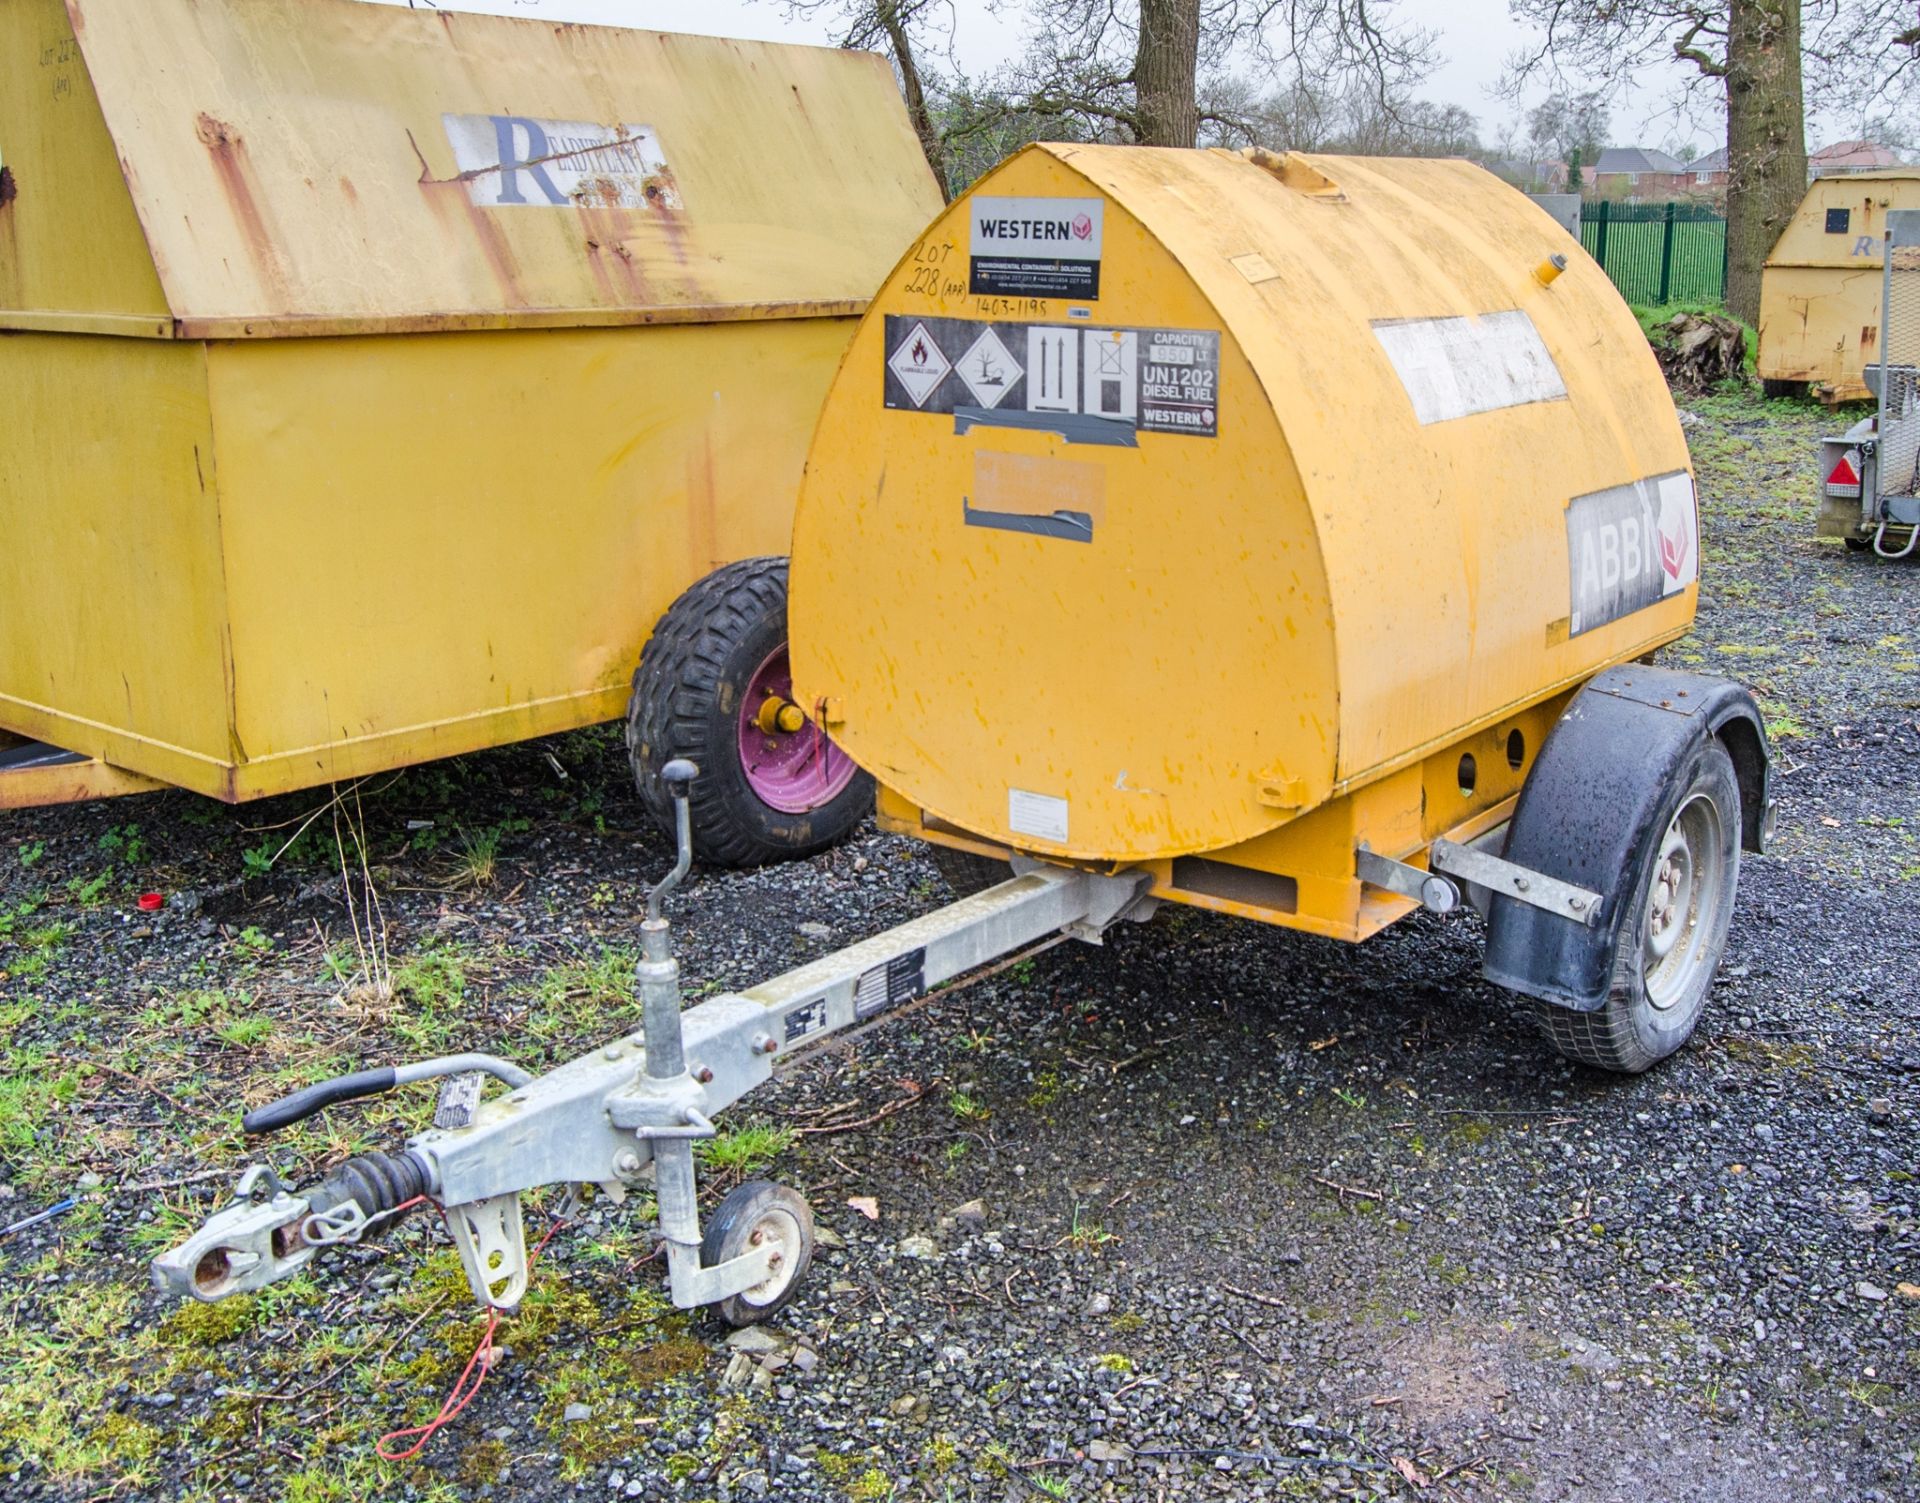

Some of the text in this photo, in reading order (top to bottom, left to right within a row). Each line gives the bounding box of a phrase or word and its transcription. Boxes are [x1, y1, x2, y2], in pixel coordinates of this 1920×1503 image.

[980, 218, 1070, 241] WESTERN
[914, 241, 954, 264] LOT
[976, 262, 1020, 271] ENVIRONMENTAL
[1060, 265, 1092, 273] SOLUTIONS
[904, 266, 967, 304] 228 (APR)
[1154, 332, 1205, 346] CAPACITY
[1157, 346, 1208, 363] 950 LT
[1143, 366, 1214, 387] UN1202
[1143, 383, 1214, 402] DIESEL FUEL
[1143, 408, 1203, 426] WESTERN
